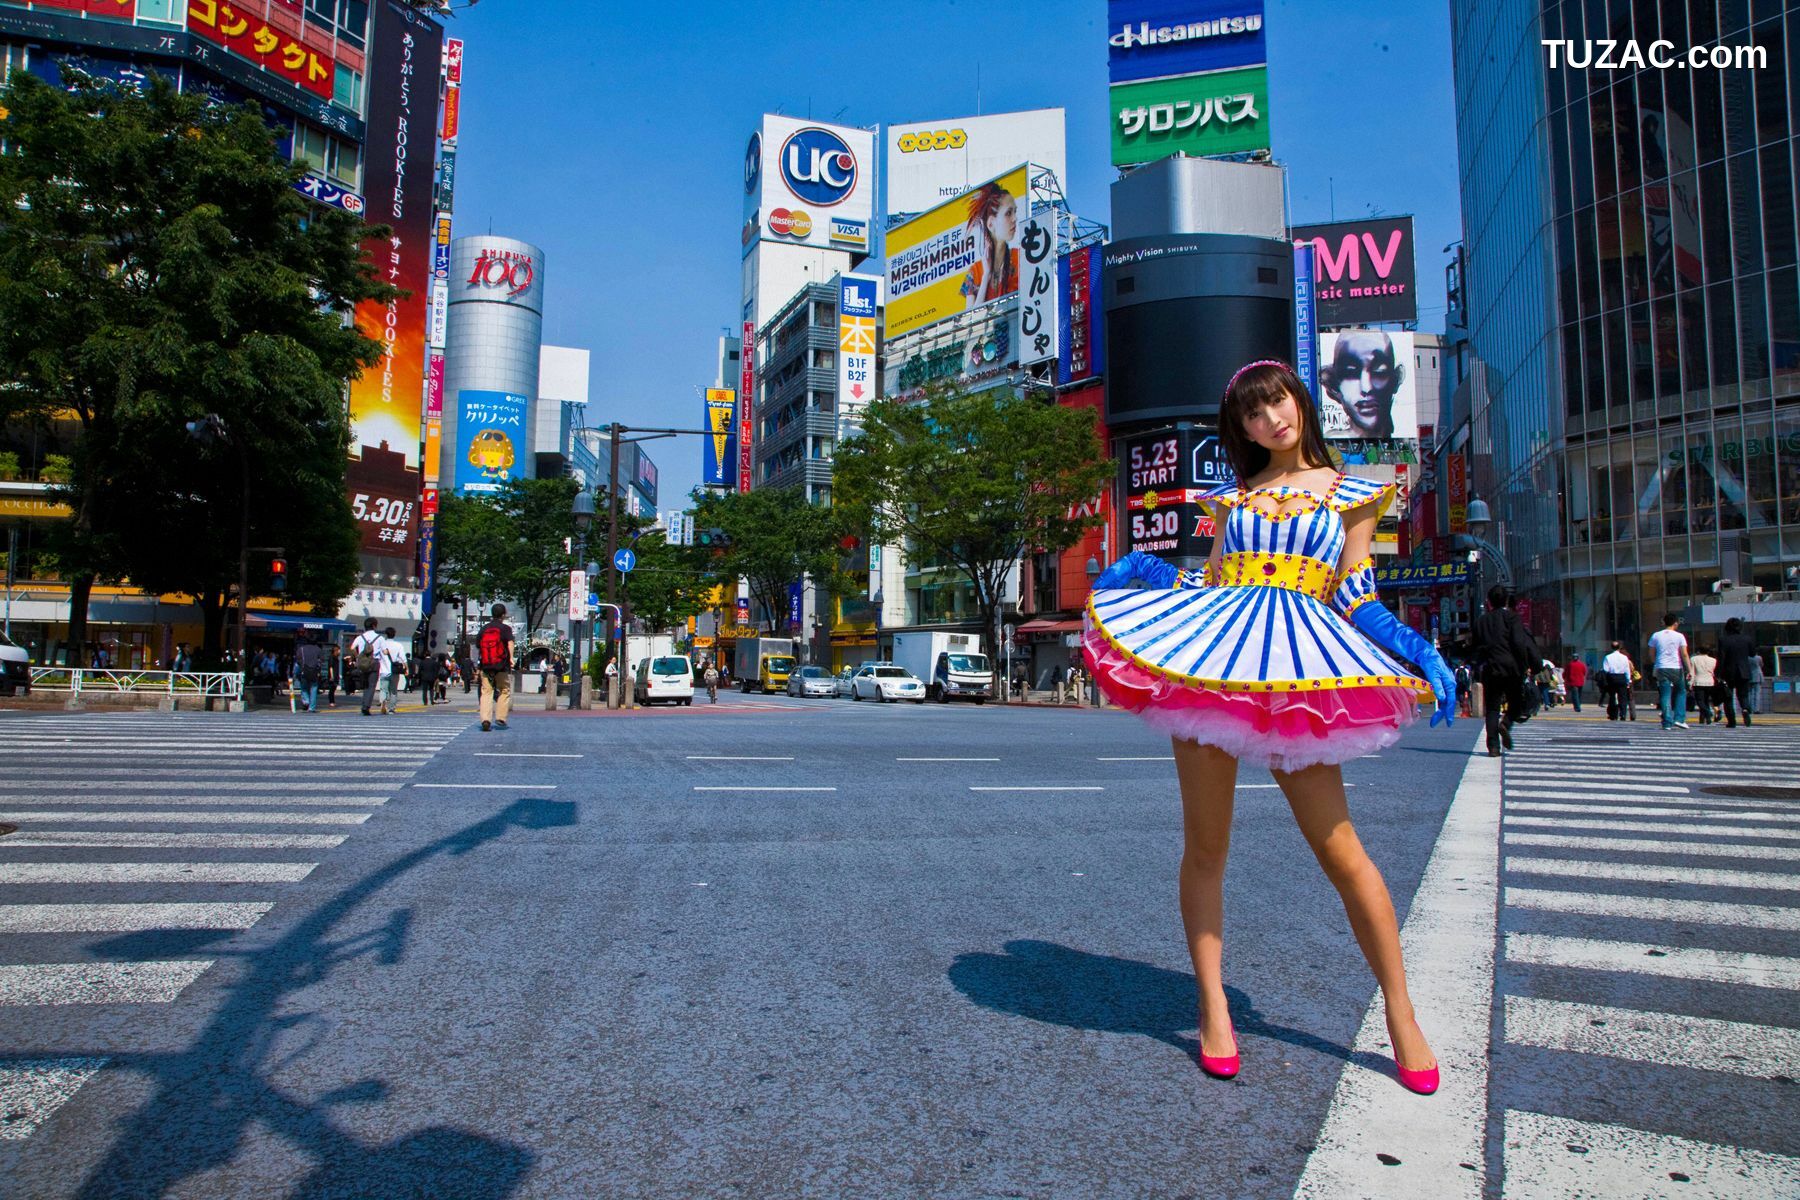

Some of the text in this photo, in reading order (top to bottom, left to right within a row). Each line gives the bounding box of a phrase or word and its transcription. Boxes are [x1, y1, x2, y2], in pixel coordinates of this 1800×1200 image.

[1109, 14, 1262, 48] Hisamitsu
[159, 36, 175, 49] 7F
[189, 0, 328, 82] コンタクト
[195, 45, 209, 59] 7F
[1119, 93, 1260, 135] サロンパス
[903, 134, 961, 147] TOPY
[345, 195, 360, 211] 6F
[770, 215, 811, 228] MasterCard
[837, 224, 860, 236] VISA
[951, 229, 963, 242] 5F
[481, 248, 532, 263] SHIBUYA
[1105, 244, 1198, 267] Mighty Vision SHIBUYA
[1296, 229, 1402, 282] MV
[466, 256, 533, 296] 109
[1021, 219, 1051, 355] もんじゃ
[1317, 282, 1405, 300] sic master
[1295, 271, 1311, 342] Taisei
[435, 291, 445, 342] 渋谷駅前ビル
[432, 355, 444, 363] 5F
[848, 357, 867, 369] B1F
[848, 370, 867, 381] B2F
[465, 410, 520, 426] クリノッペ
[1131, 439, 1178, 470] 5.23
[1132, 466, 1177, 488] START
[352, 493, 413, 527] 5.30 SAT
[1132, 510, 1179, 540] 5.30
[378, 527, 408, 544] 卒業
[1132, 539, 1178, 553] ROADSHOW
[1376, 563, 1467, 581] 歩きタバコ禁止
